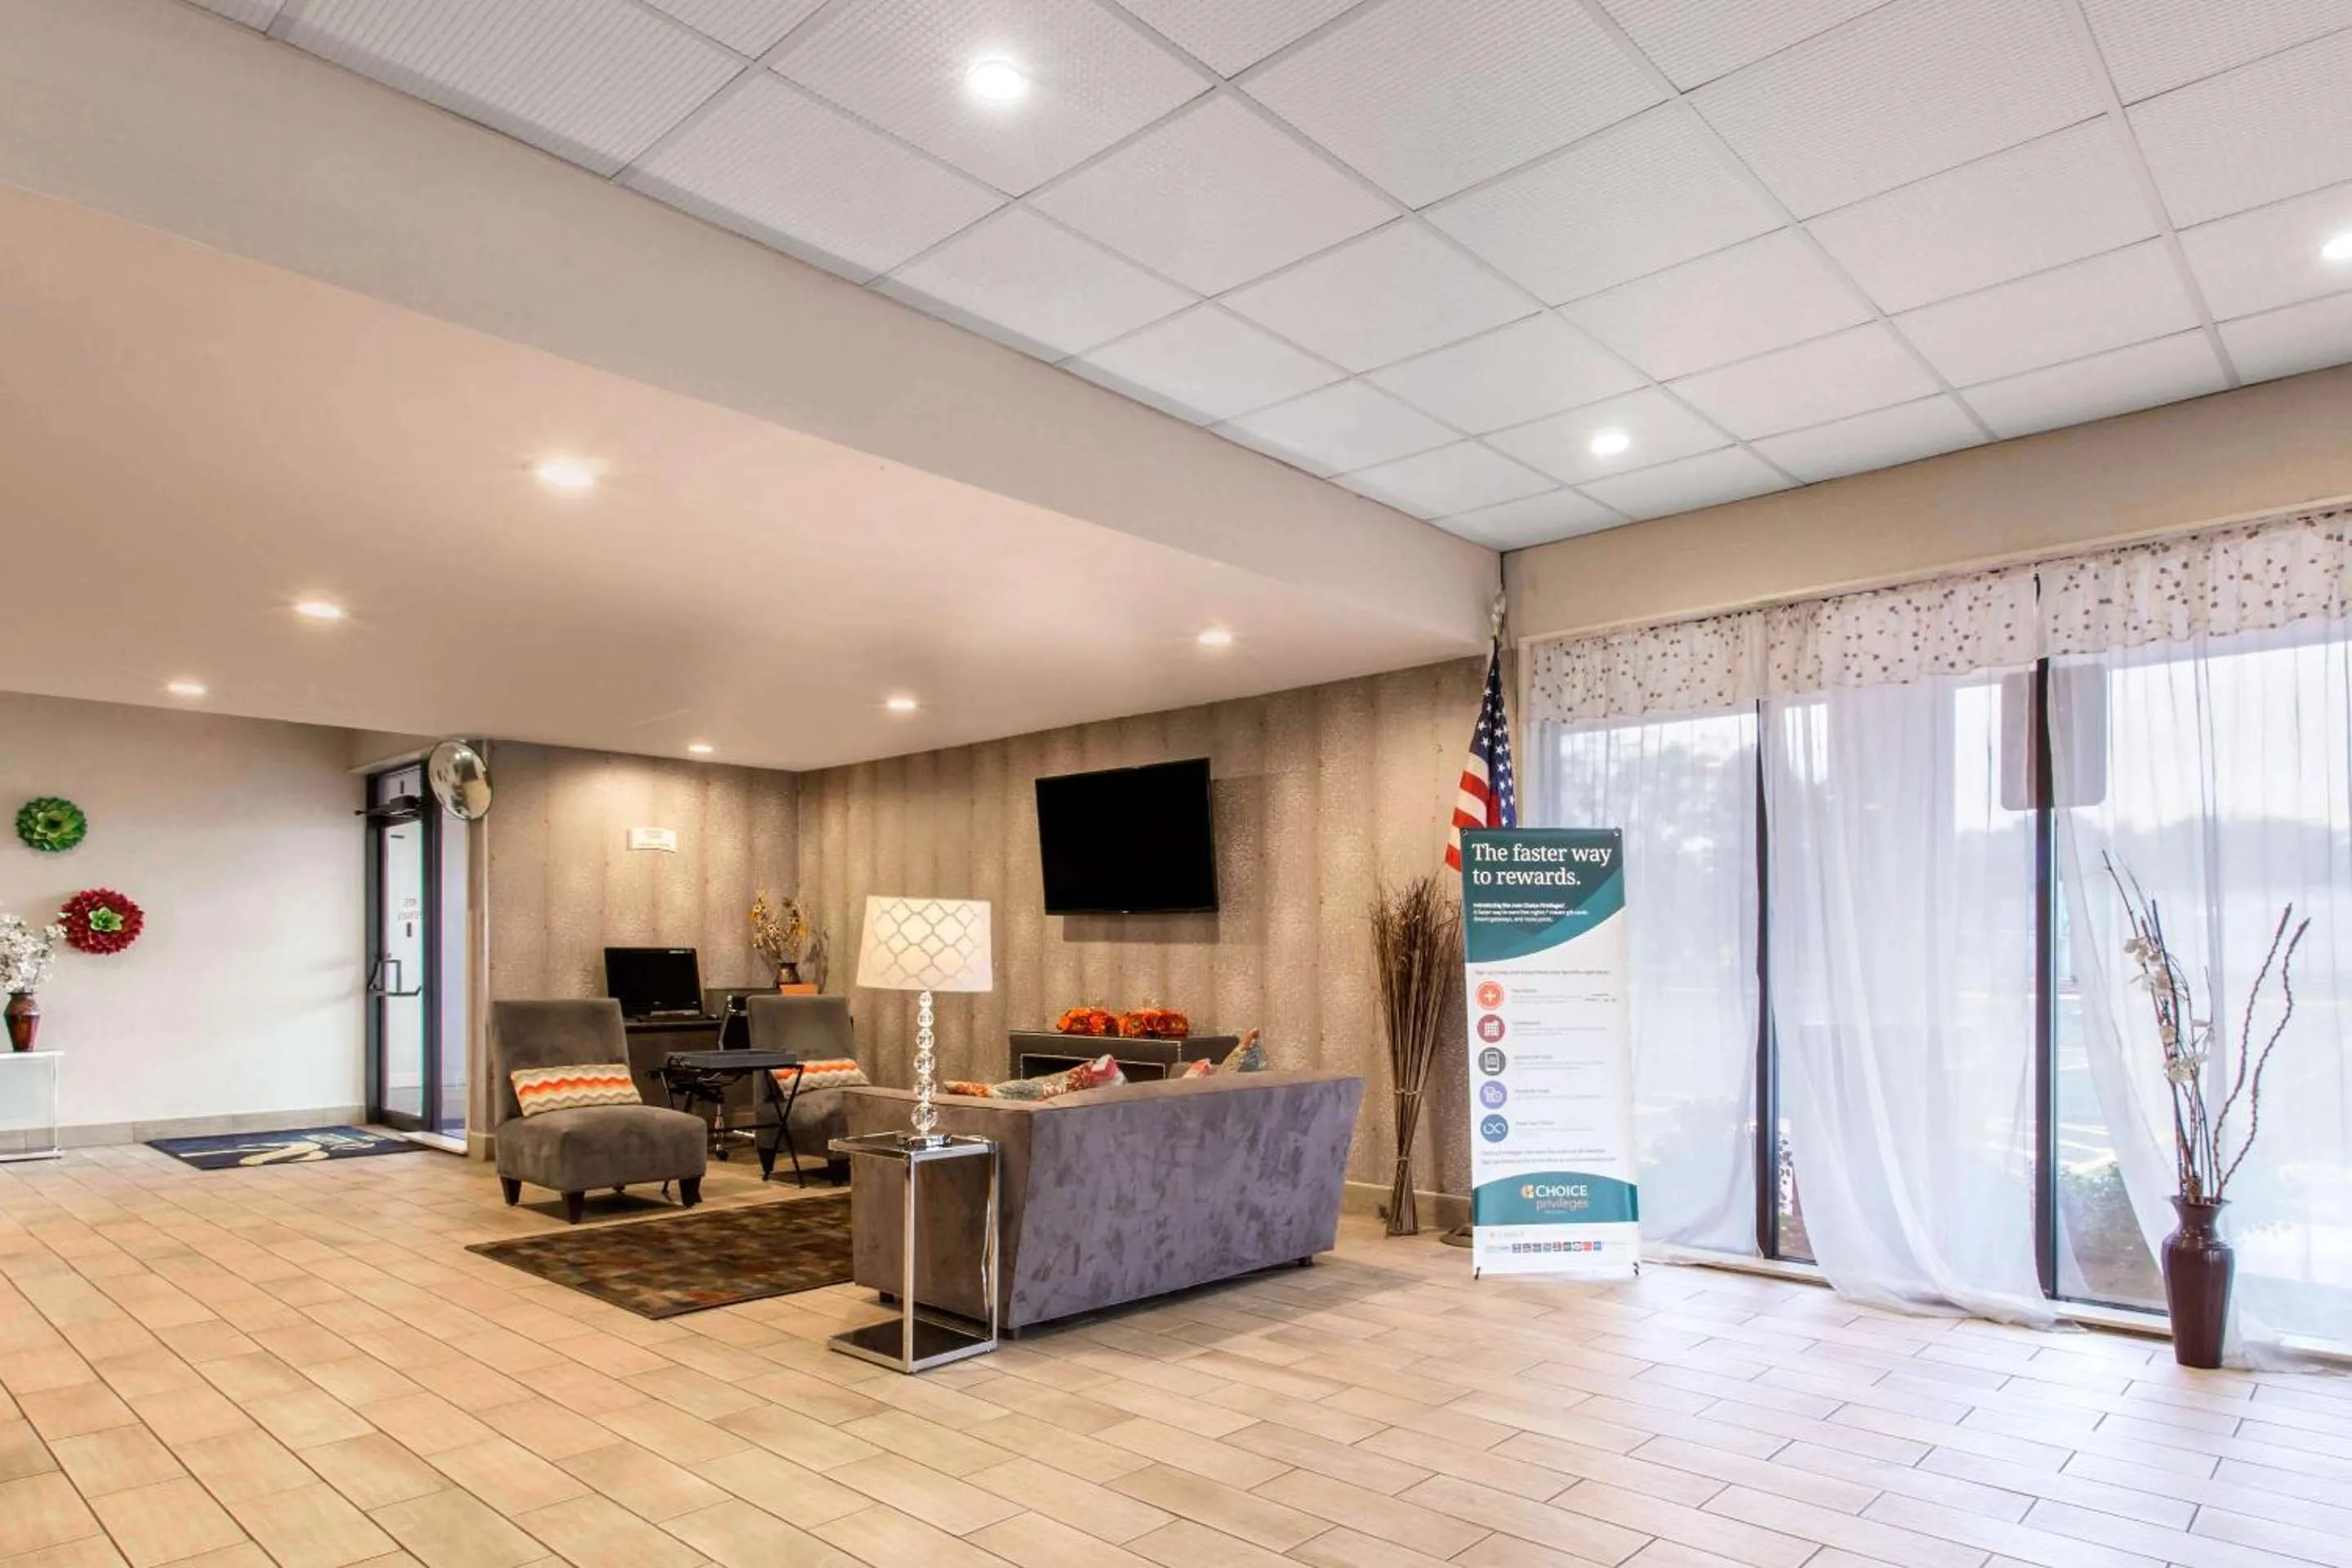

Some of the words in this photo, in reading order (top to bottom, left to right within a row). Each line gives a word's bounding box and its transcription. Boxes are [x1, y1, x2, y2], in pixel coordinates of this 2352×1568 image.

[1472, 843, 1508, 862] The
[1512, 843, 1567, 862] faster
[1570, 848, 1612, 866] way
[1472, 868, 1492, 885] to
[1495, 866, 1581, 885] rewards.
[1535, 1185, 1588, 1198] CHOICE
[1536, 1198, 1588, 1212] privileges
